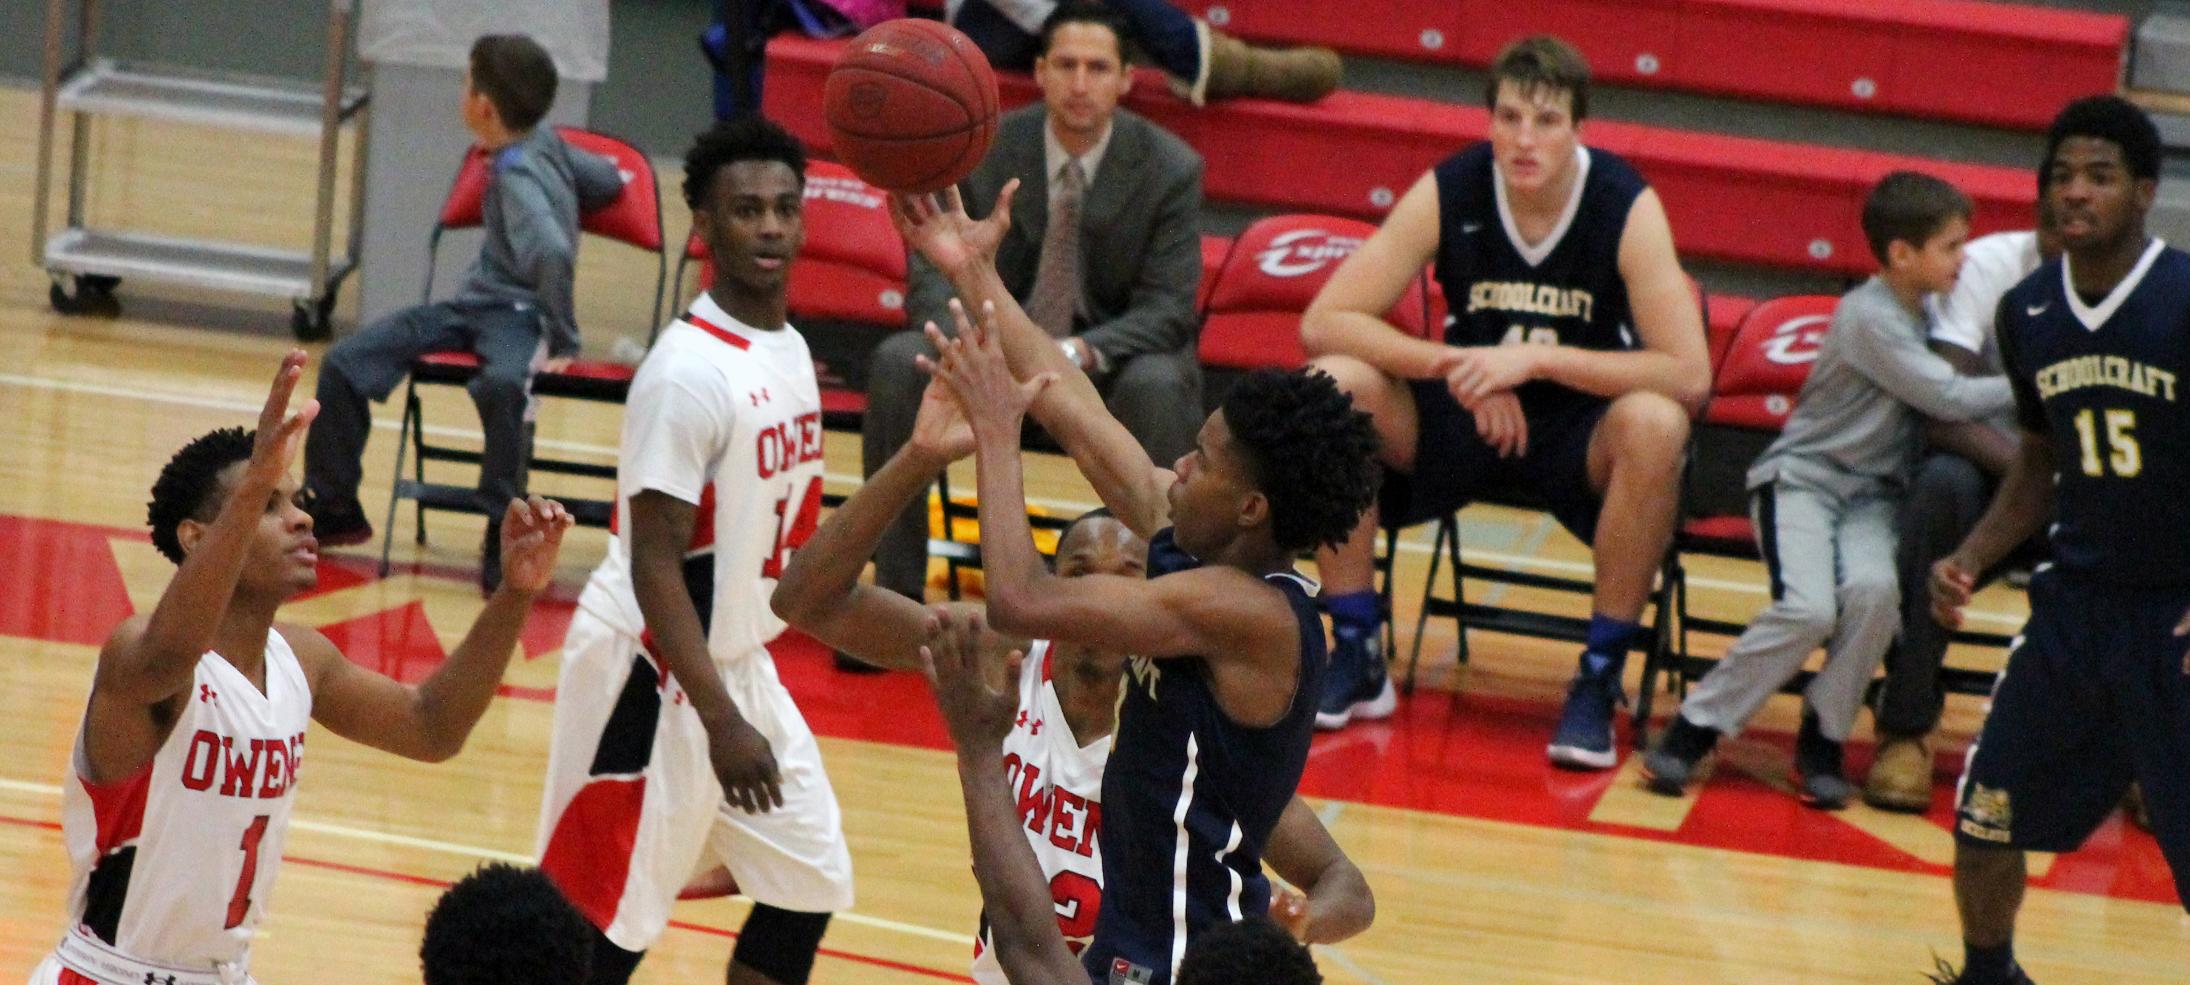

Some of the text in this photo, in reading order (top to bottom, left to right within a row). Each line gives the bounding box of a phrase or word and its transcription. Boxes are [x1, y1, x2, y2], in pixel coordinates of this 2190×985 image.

[1466, 281, 1593, 322] SCHOOLCRAFT
[2036, 354, 2177, 401] SCHOOLCRAFT
[2074, 408, 2142, 478] 15
[1002, 751, 1104, 858] OWEN
[223, 814, 271, 930] 1
